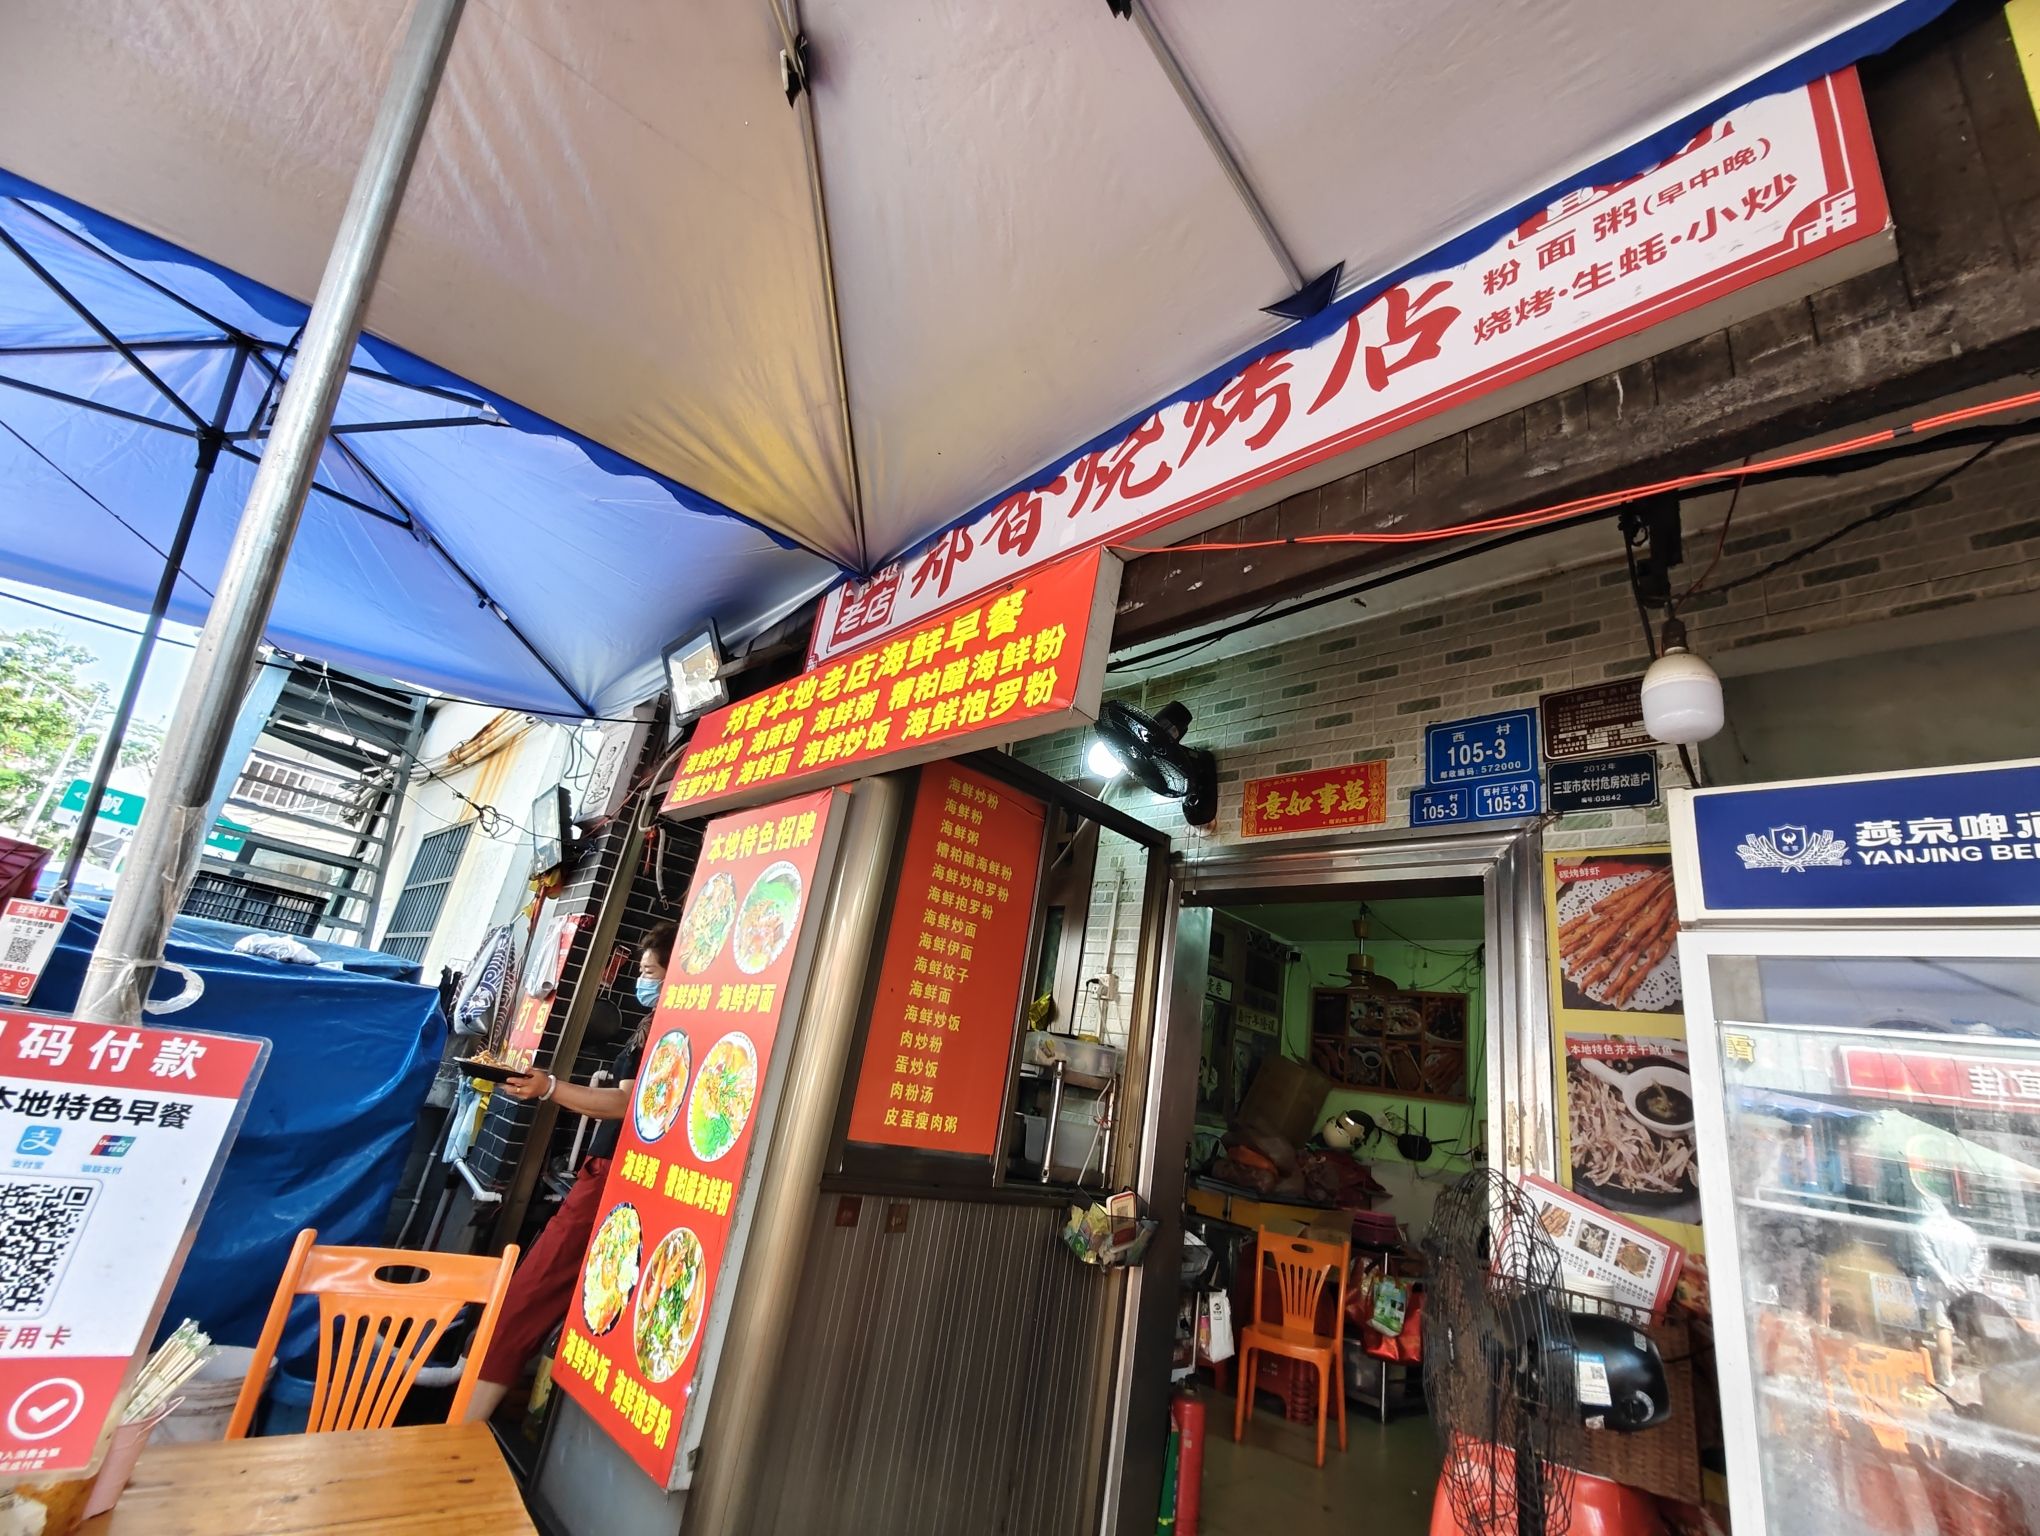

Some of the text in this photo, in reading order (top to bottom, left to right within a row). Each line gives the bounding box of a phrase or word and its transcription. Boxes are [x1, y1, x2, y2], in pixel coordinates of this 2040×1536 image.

[1482, 259, 1521, 296] 粉
[1536, 228, 1577, 269] 面
[836, 586, 895, 635] 老店
[721, 588, 1027, 738] 郑香本地老店海鲜早餐
[681, 737, 743, 775] 海鲜炒粉
[810, 688, 880, 735] 海鲜粥
[735, 746, 795, 786] 海鲜面
[798, 716, 892, 768] 海鲜炒饭
[901, 665, 1058, 741] 海鲜抱罗粉
[1447, 738, 1507, 767] 105-3
[1583, 762, 1617, 774] 2012年
[947, 776, 999, 810] 海鲜炒粉
[1552, 771, 1651, 795] 三亚市农村危房改造户
[944, 797, 983, 825] 海鲜粉
[1422, 803, 1458, 820] 105-3
[1486, 793, 1527, 813] 105-3
[706, 810, 818, 864] 本地特色招牌
[940, 818, 980, 847] 海鲜粥
[1857, 843, 2040, 865] YANJING BE
[931, 862, 1009, 903] 海鲜炒抱罗粉
[927, 885, 994, 920] 海鲜抱罗粉
[923, 908, 978, 939] 海鲜炒面
[918, 931, 974, 962] 海鲜伊面
[913, 955, 969, 984] 海鲜饺子
[662, 983, 713, 1011] 海鲜炒粉
[909, 979, 952, 1005] 海鲜面
[904, 1004, 961, 1032] 海鲜炒饭
[0, 1019, 207, 1080] 码付款
[900, 1029, 943, 1054] 肉炒粉
[895, 1054, 938, 1078] 蛋炒饭
[890, 1080, 934, 1104] 肉粉汤
[884, 1106, 958, 1134] 皮蛋瘦肉粥
